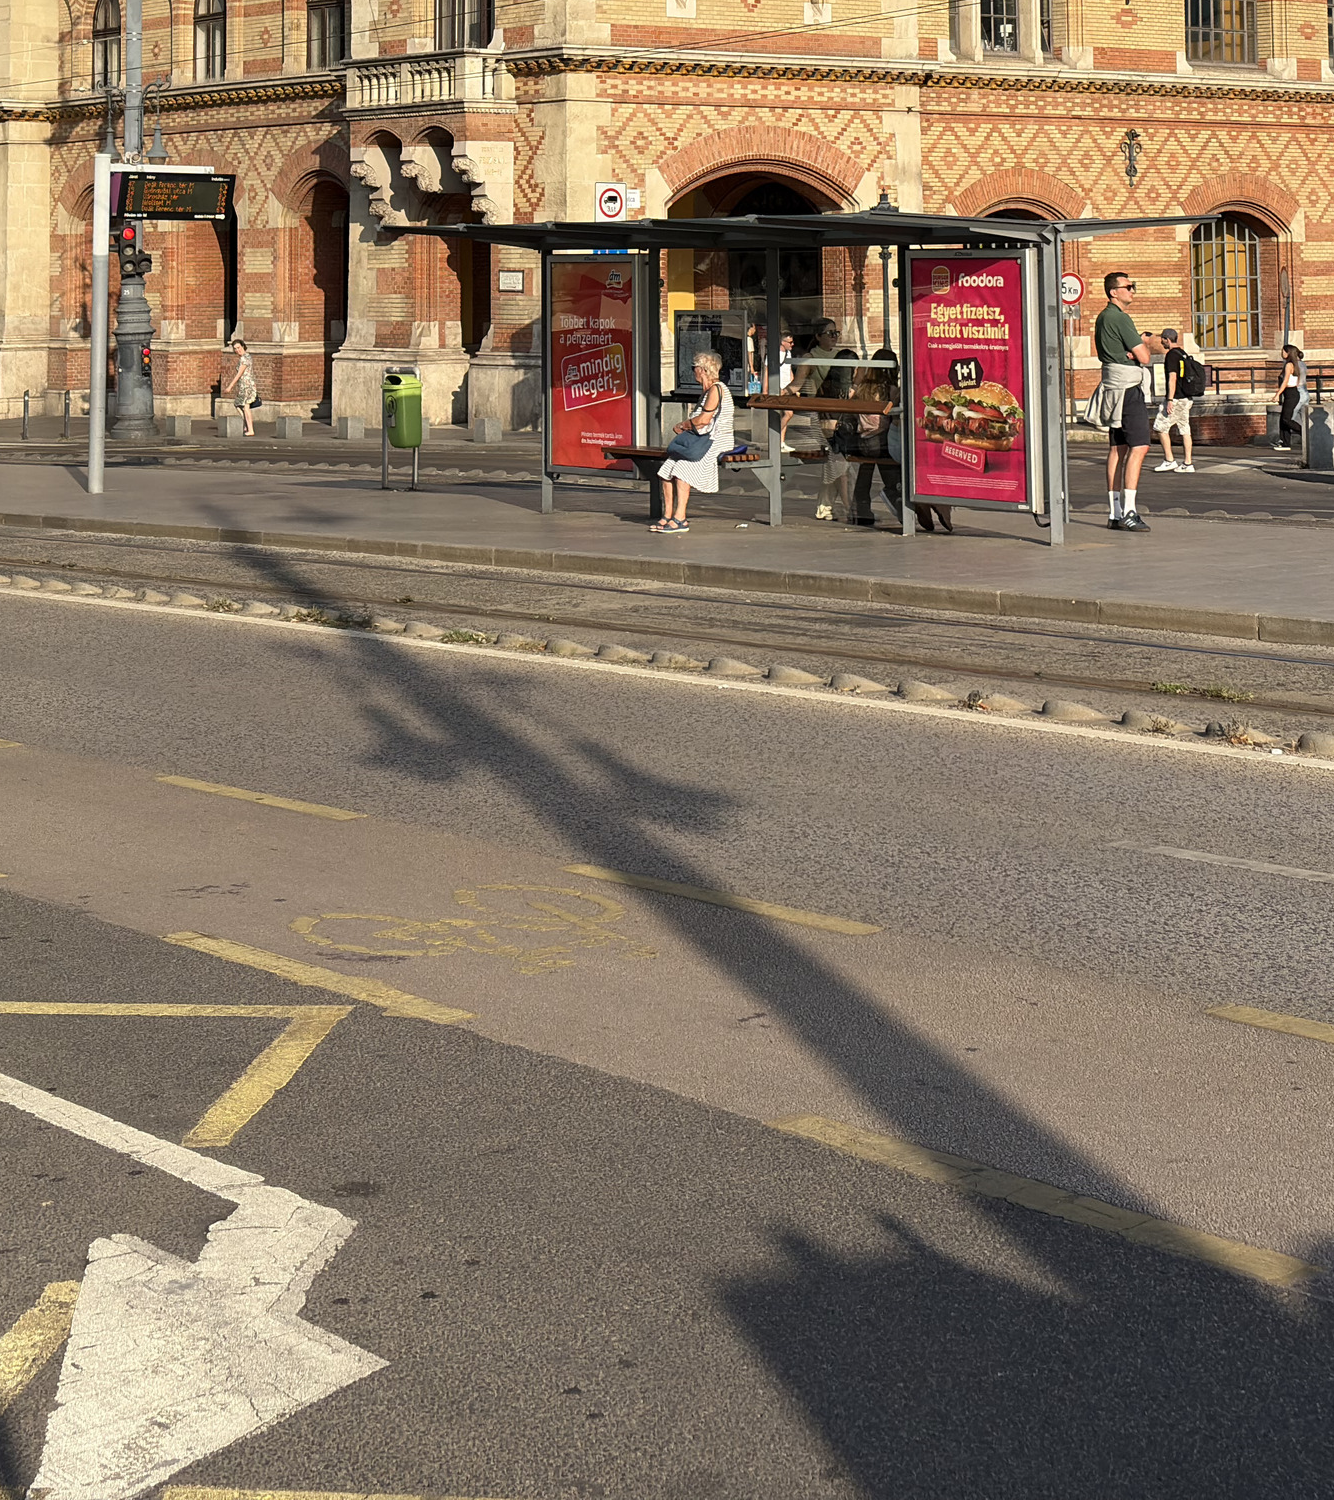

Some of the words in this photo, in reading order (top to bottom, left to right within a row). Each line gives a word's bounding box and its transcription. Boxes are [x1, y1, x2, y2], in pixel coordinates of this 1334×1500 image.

[959, 273, 1004, 287] foodora
[930, 303, 961, 322] Egyet
[962, 304, 1005, 322] fizetsz,
[560, 315, 587, 329] Többet
[589, 315, 616, 330] kapok
[927, 322, 961, 338] kettőt
[962, 323, 1009, 339] viszünk!
[560, 335, 565, 344] a
[567, 332, 612, 347] pénzemért
[580, 354, 622, 378] mindig
[954, 361, 976, 380] 1+1
[945, 446, 978, 463] RESERVED
